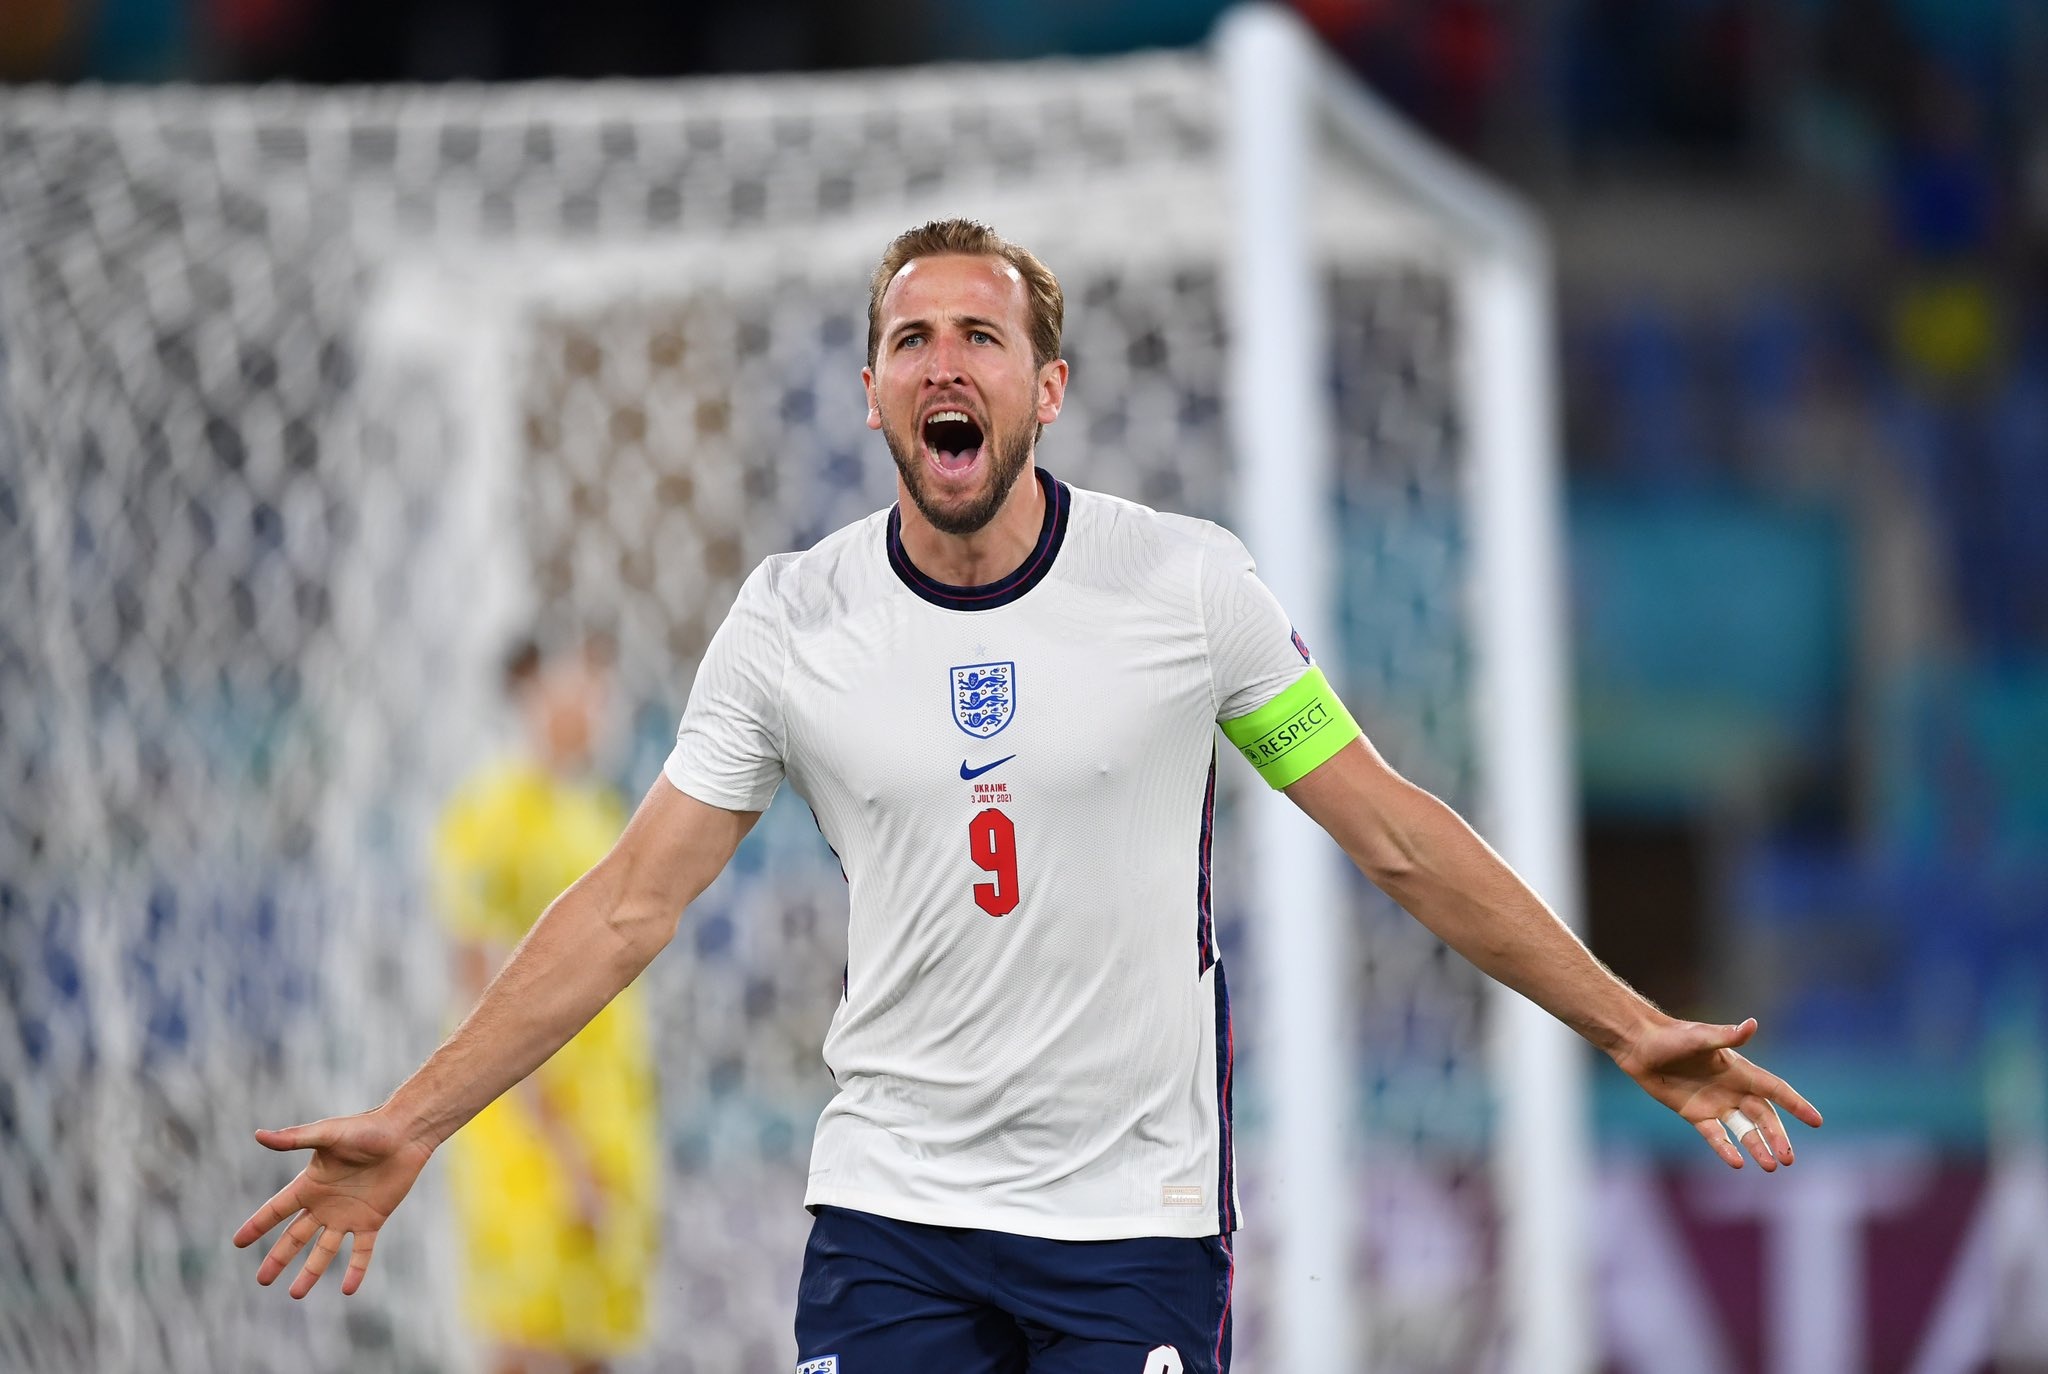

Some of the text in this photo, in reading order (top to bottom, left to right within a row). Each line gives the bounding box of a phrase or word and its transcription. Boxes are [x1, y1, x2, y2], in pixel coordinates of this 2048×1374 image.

[1258, 702, 1328, 758] RESPECT
[974, 783, 1007, 793] UKRAINE
[977, 794, 995, 803] JULY
[996, 793, 1012, 803] 2021
[969, 808, 1019, 917] 9
